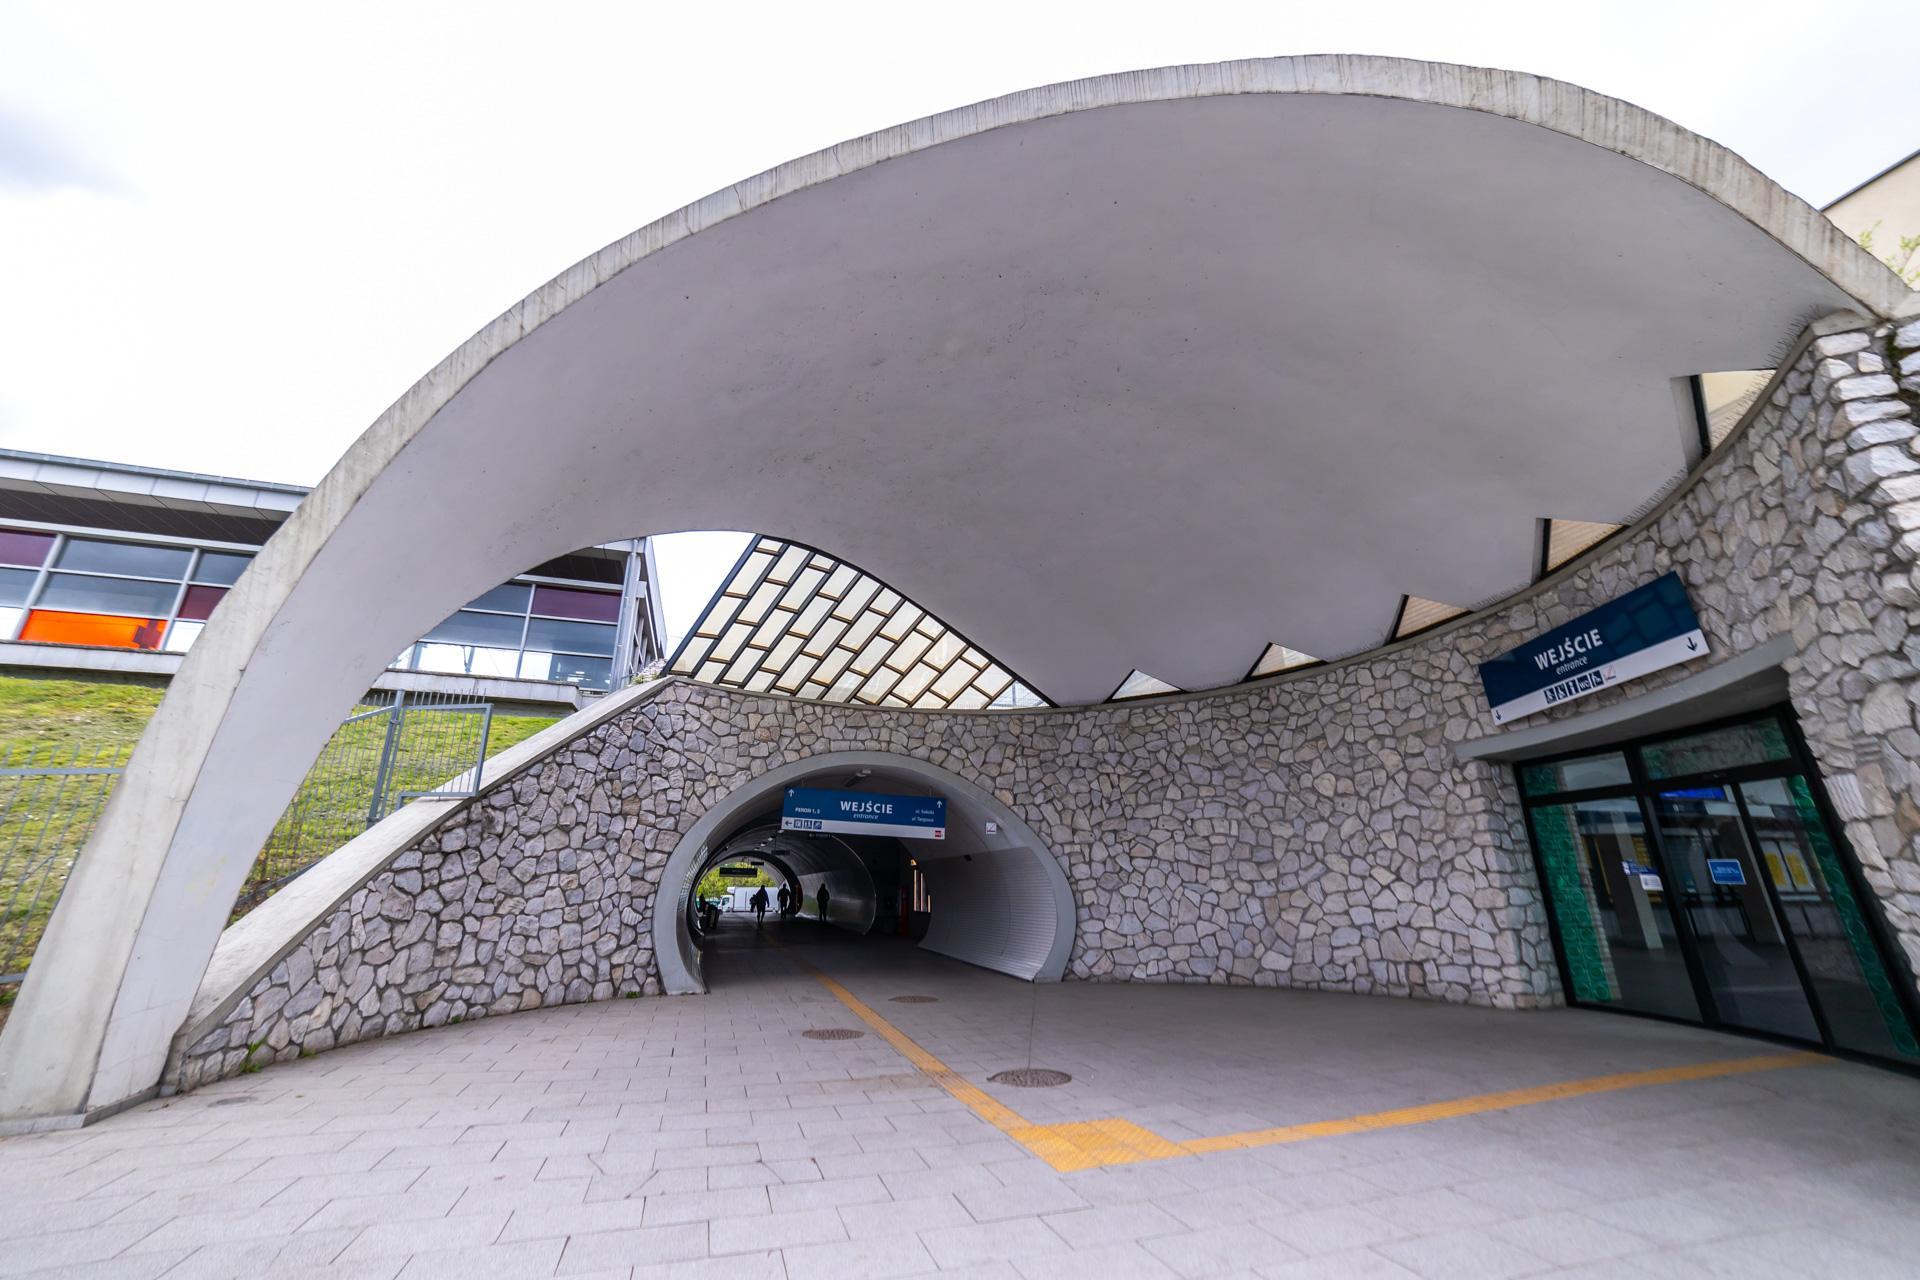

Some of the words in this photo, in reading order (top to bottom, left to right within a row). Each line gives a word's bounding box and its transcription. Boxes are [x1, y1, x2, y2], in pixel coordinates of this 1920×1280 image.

[1534, 629, 1603, 670] WEJŚCIE
[1556, 656, 1588, 675] entrance
[840, 800, 893, 814] WEJŚCIE
